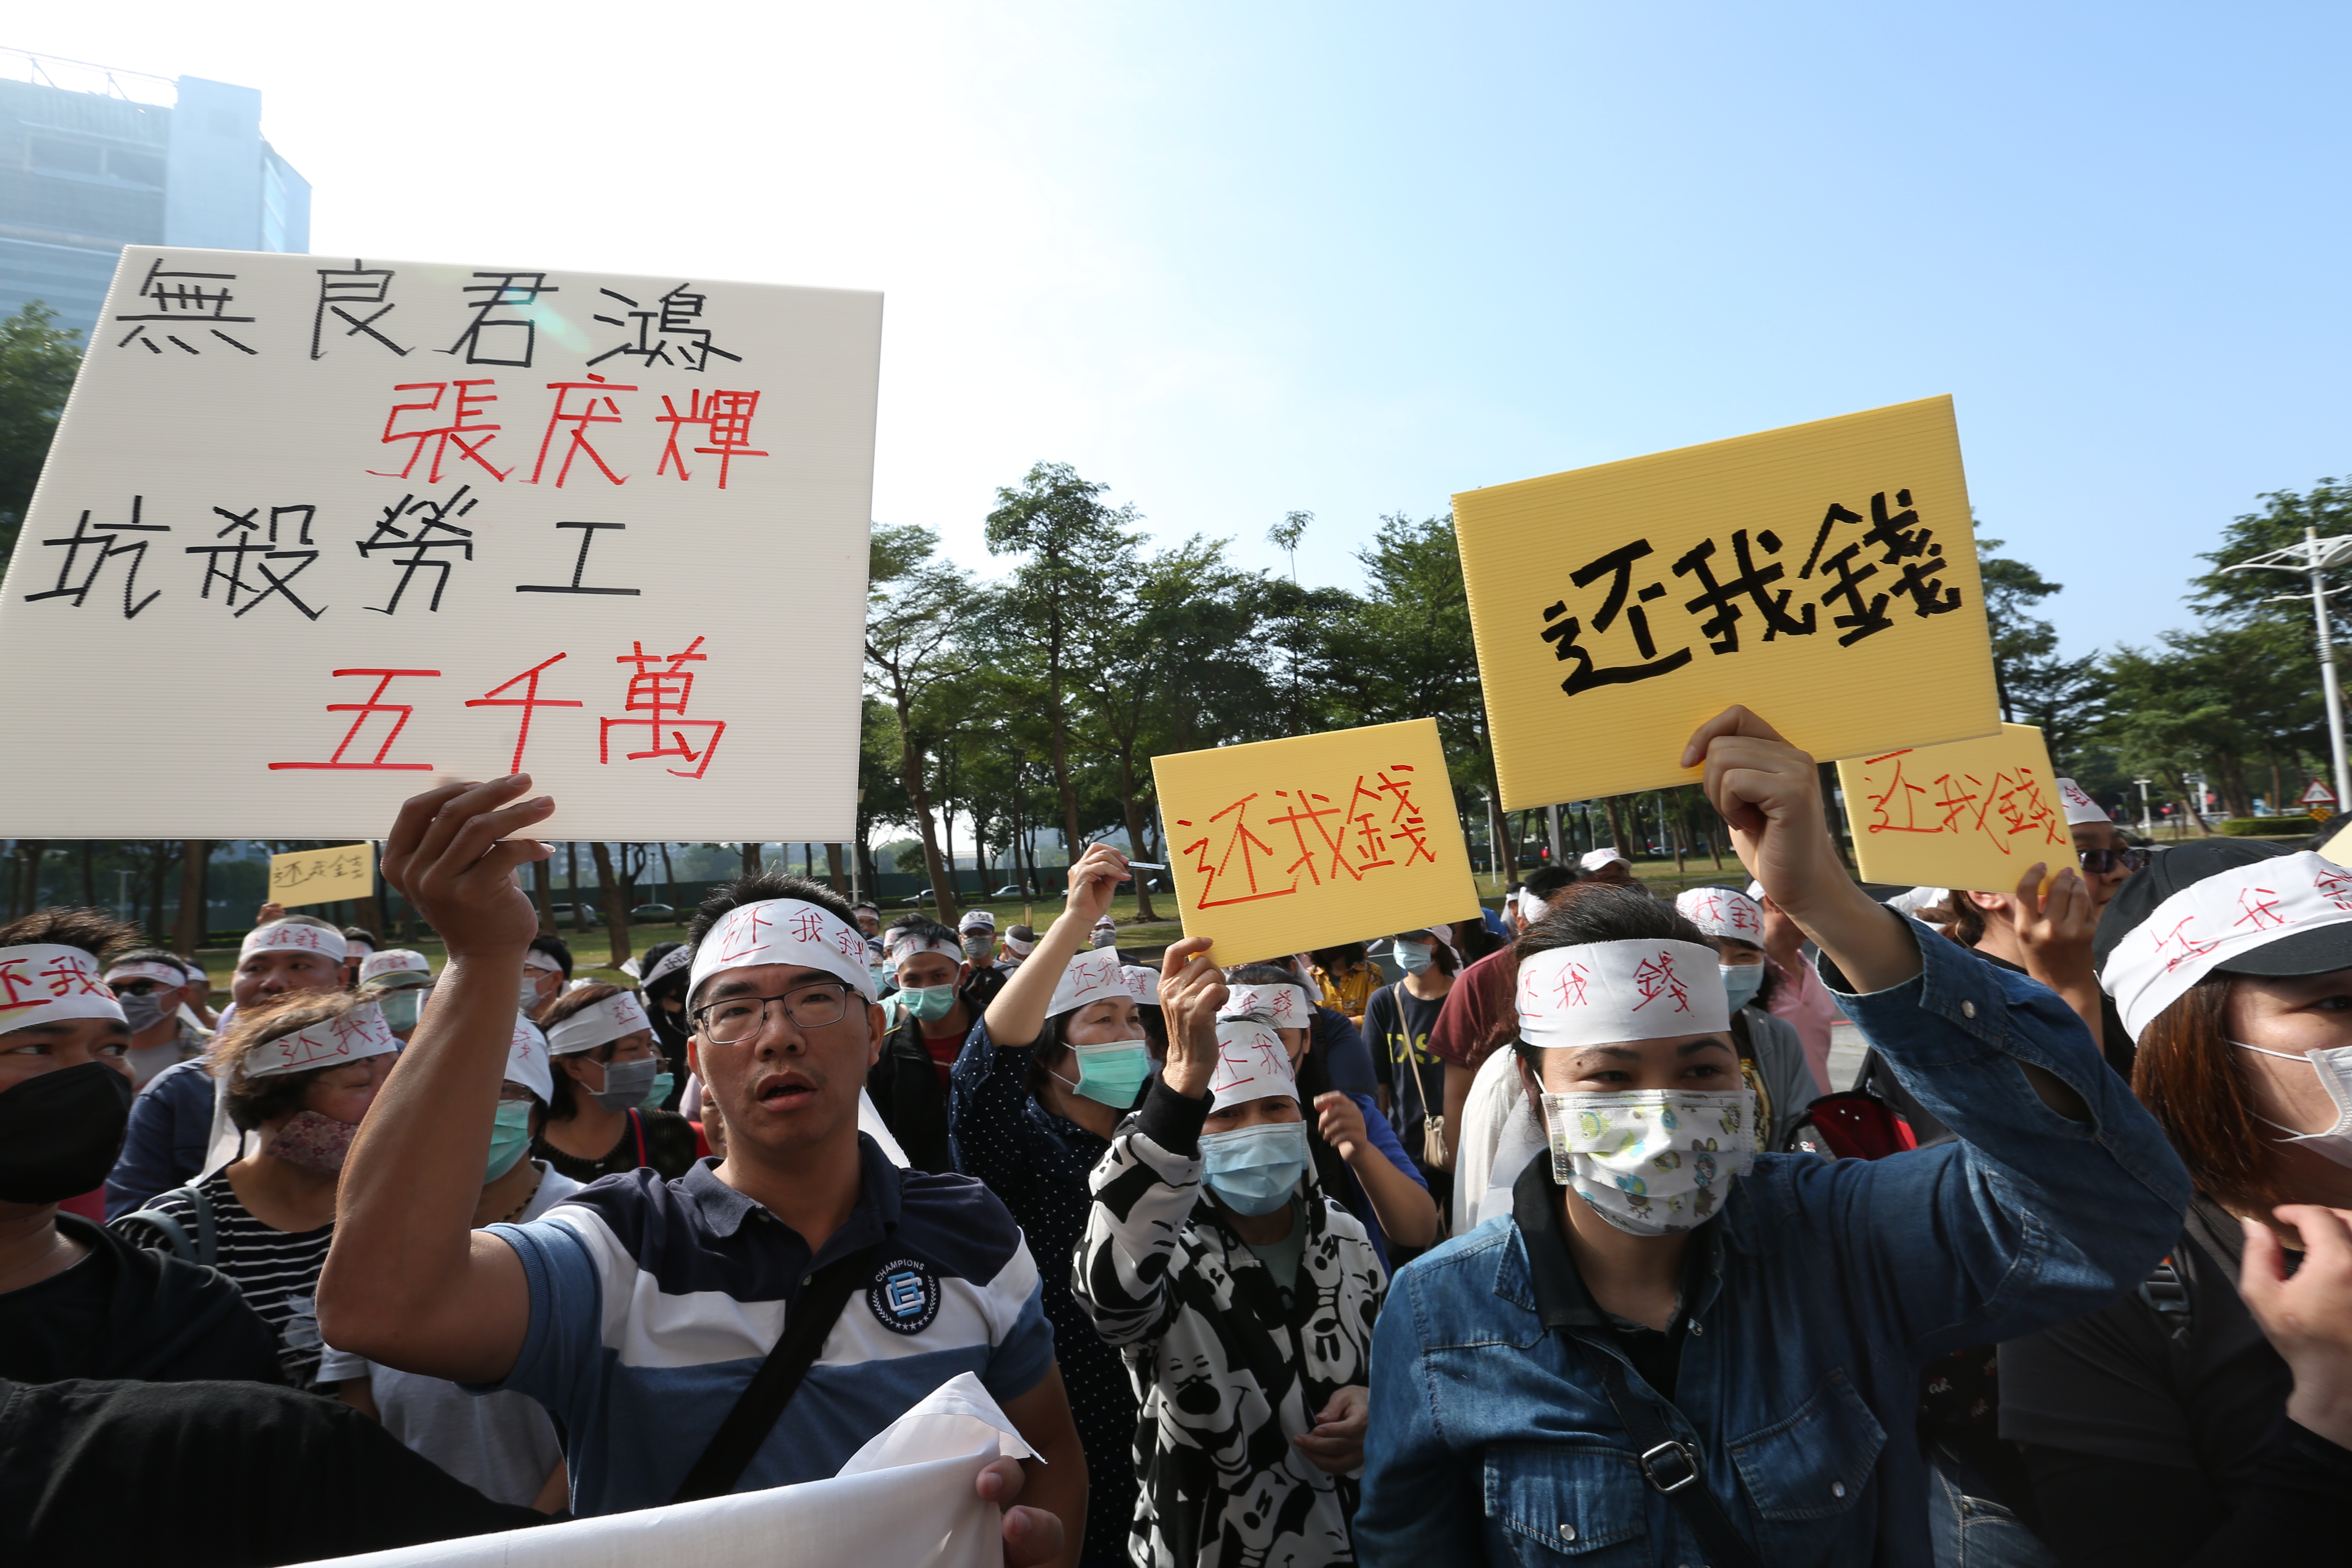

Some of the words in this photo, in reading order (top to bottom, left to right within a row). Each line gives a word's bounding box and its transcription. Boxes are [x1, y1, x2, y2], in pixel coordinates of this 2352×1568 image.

[116, 258, 742, 371] 無良君鴻
[25, 485, 640, 620] 坑殺勞工
[1541, 488, 1961, 697] 还我錢
[269, 636, 726, 779] 五千萬
[1177, 764, 1437, 910] 还我錢
[1864, 748, 2066, 855] 还我錢
[875, 1259, 924, 1282] CHAMPIONS
